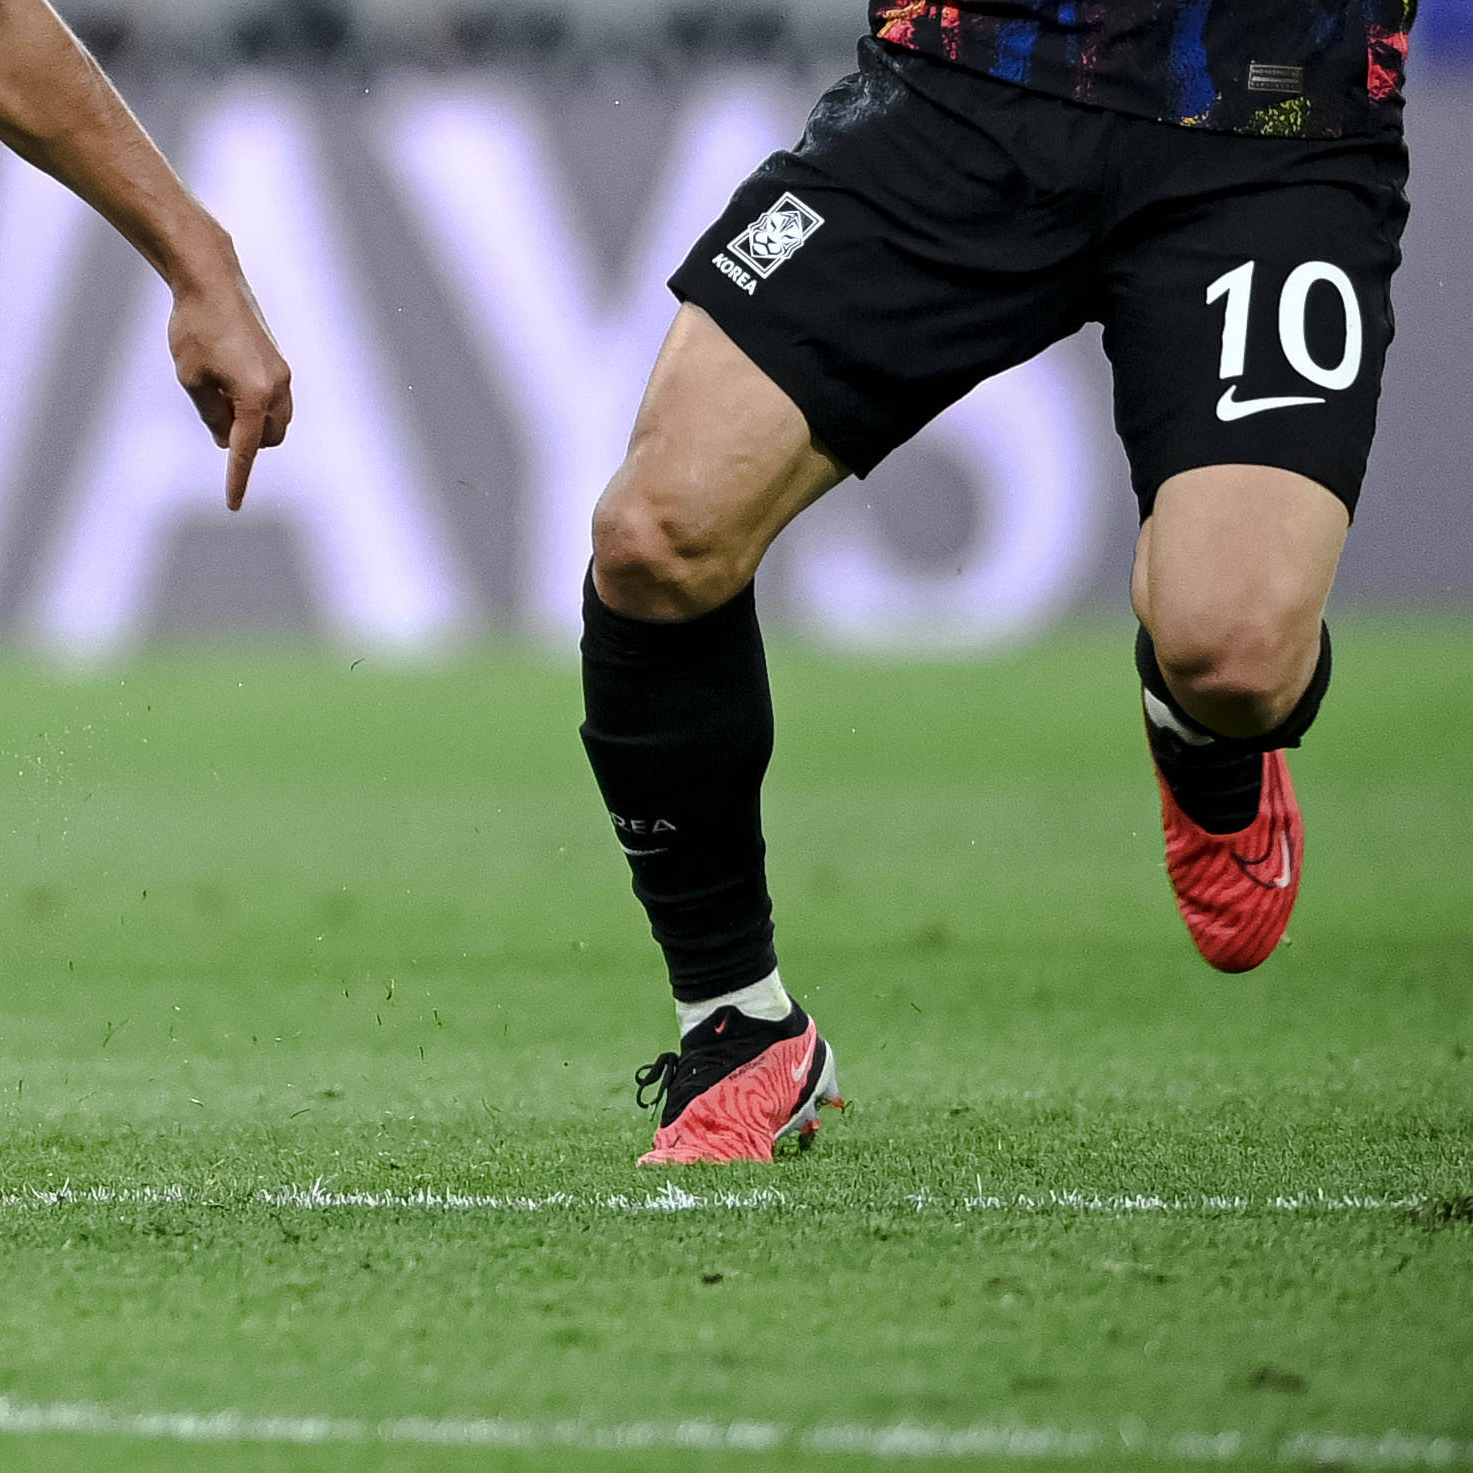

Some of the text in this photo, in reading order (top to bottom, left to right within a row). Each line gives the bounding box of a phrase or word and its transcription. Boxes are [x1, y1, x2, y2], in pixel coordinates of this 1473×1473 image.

[711, 253, 758, 296] KOREA
[1206, 260, 1363, 391] 10
[611, 812, 677, 834] REA
